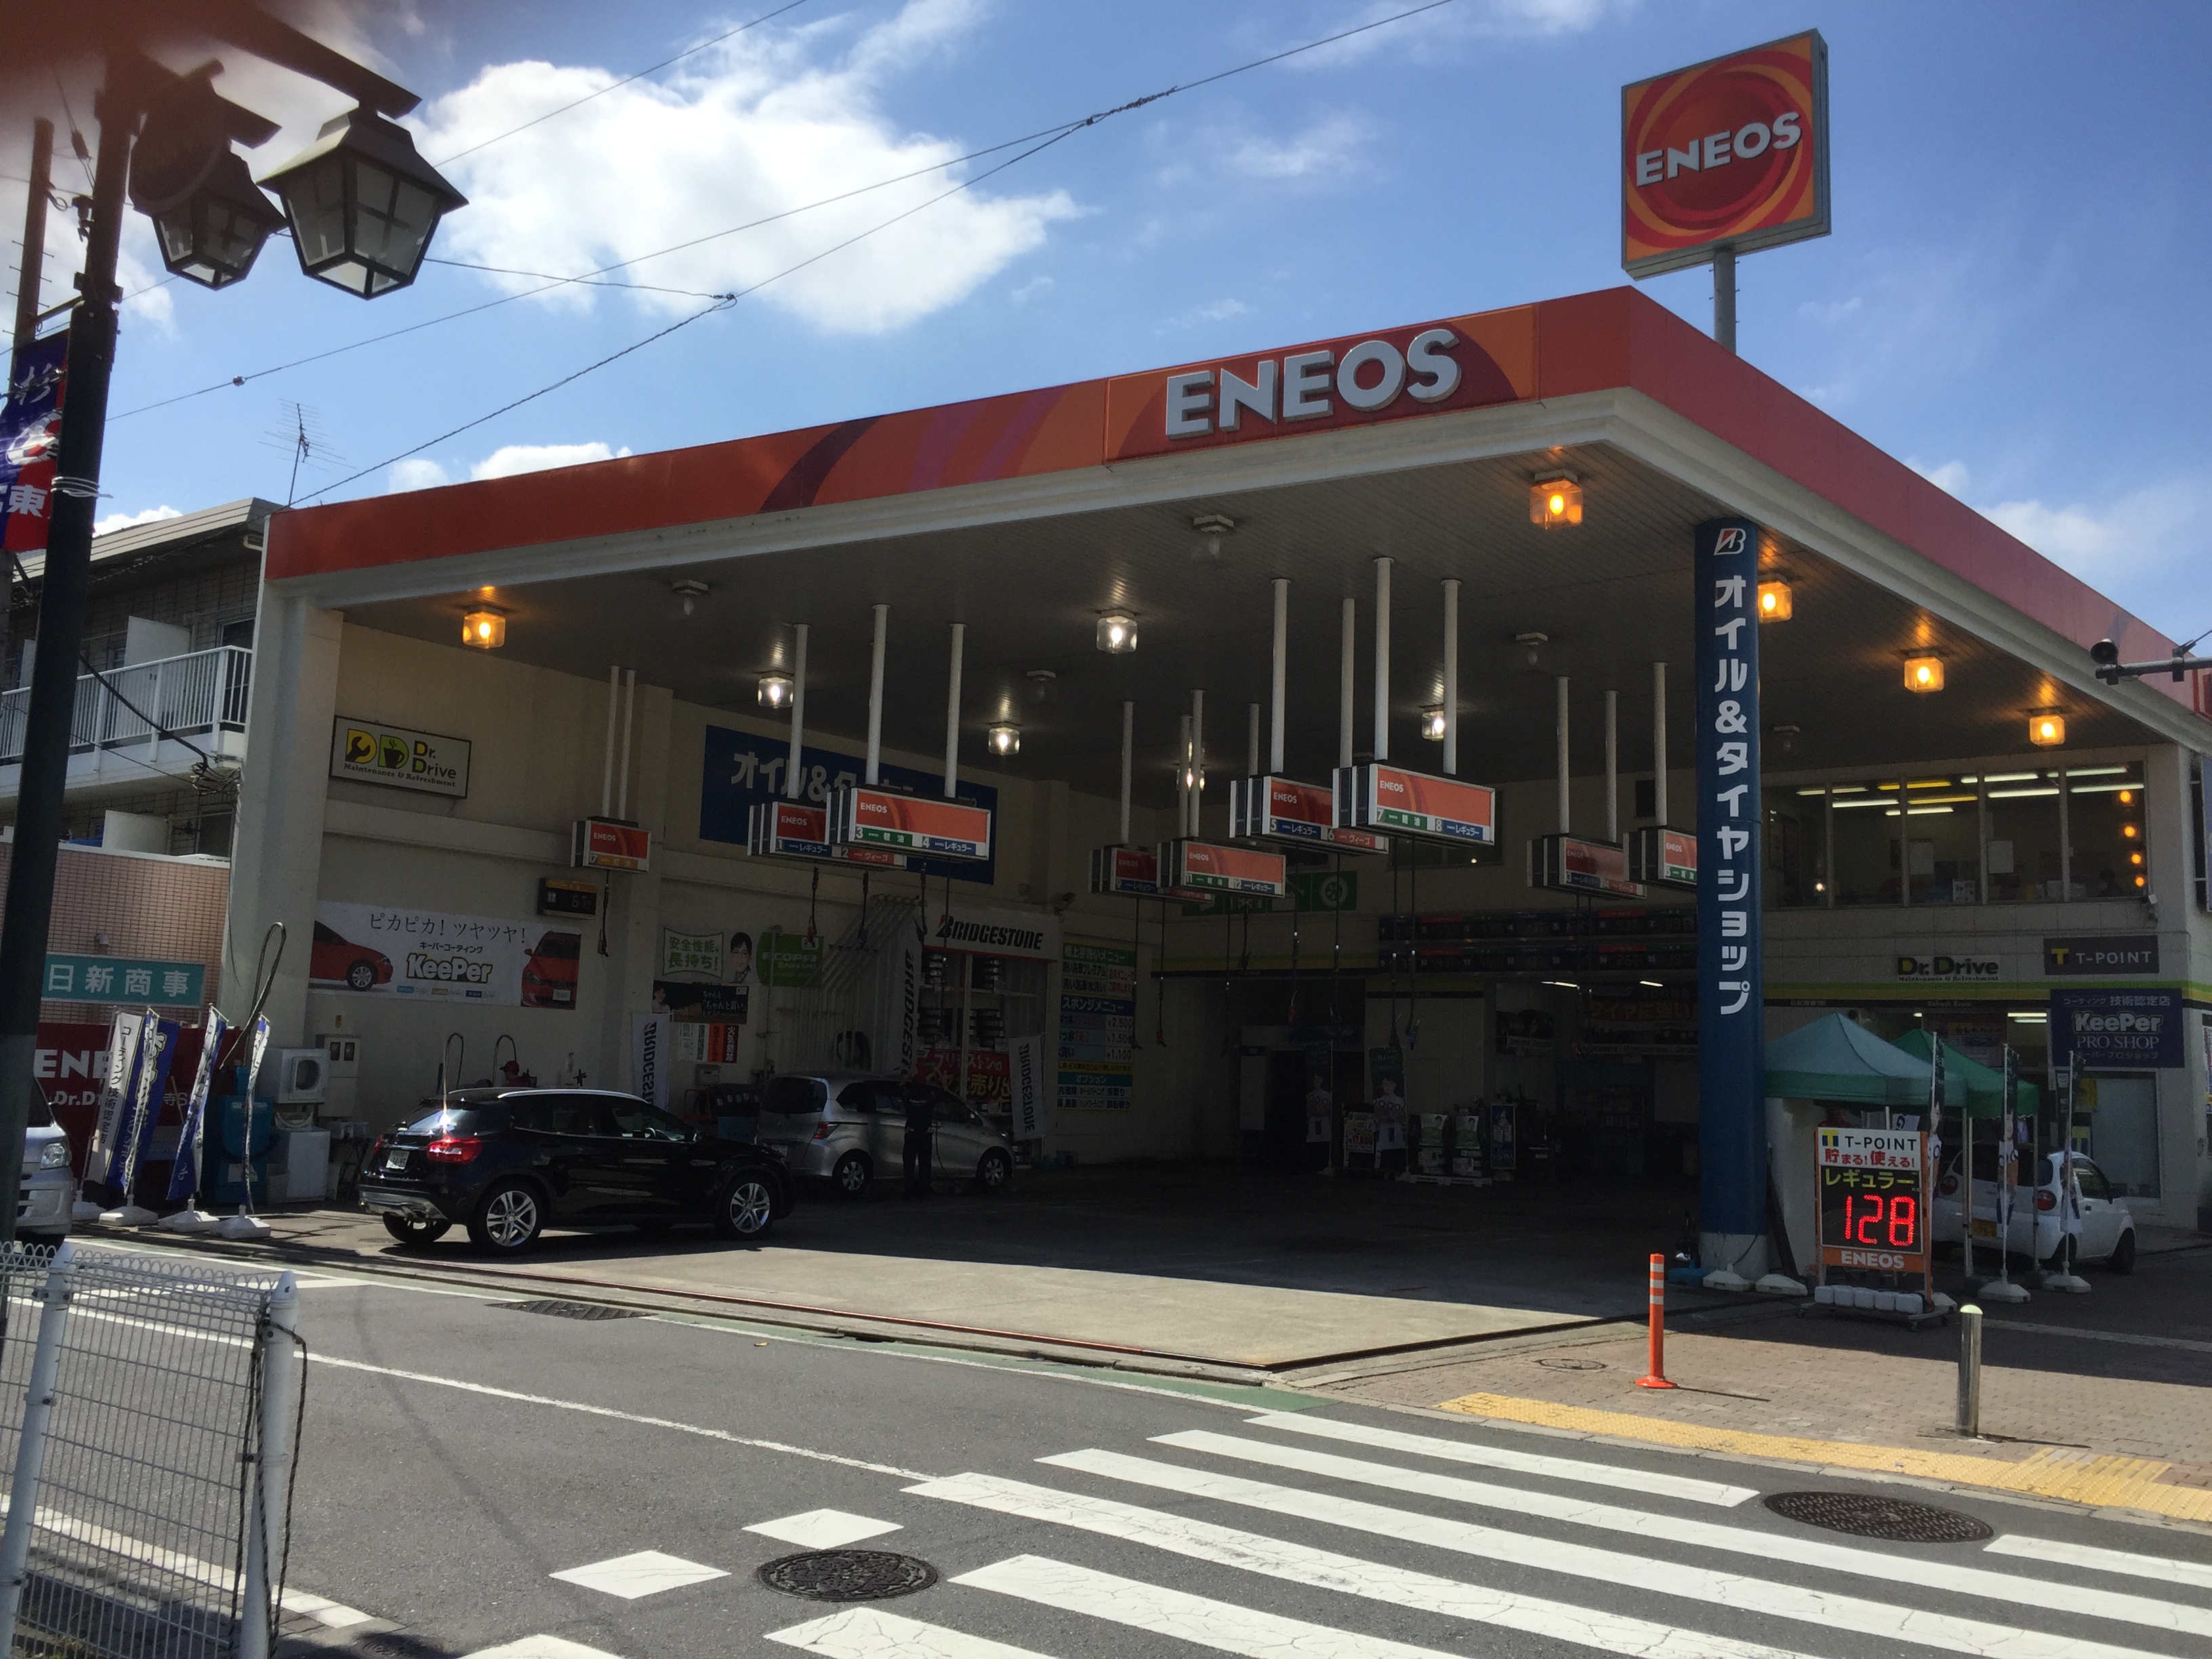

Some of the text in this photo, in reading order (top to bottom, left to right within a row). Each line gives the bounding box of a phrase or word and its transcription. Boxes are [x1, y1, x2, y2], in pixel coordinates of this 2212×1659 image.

[1637, 111, 1802, 187] ENEOS
[1165, 328, 1461, 440] ENEOS
[413, 740, 436, 759] Dr.
[411, 757, 457, 779] Drive
[343, 763, 395, 778] Maintenance
[406, 773, 455, 787] Refreshment
[1380, 780, 1404, 793] ENEOS
[1273, 792, 1297, 804] ENEOS
[1714, 575, 1750, 1015] オイル&タイヤショップ
[860, 802, 887, 813] ENEOS
[781, 815, 807, 826] ENEOS
[1377, 809, 1384, 821] 7
[1271, 819, 1277, 832] 5
[1291, 823, 1317, 835] レギュラー
[1435, 819, 1442, 832] 8
[1455, 824, 1479, 836] レギュラー
[594, 832, 617, 842] ENEOS
[856, 827, 863, 838] 3
[1328, 829, 1335, 841] 6
[799, 842, 828, 853] レギュラー
[922, 836, 930, 848] 4
[944, 841, 972, 853] レギュラー
[589, 855, 598, 863] 17
[842, 847, 848, 858] 2
[864, 851, 888, 862] ヴィーゴ
[1189, 852, 1209, 861] ENEOS
[1119, 859, 1139, 867] ENEOS
[370, 913, 525, 943] ピカピカ! ツヤツヤ!
[935, 914, 1044, 950] BRIDGESTONE
[2075, 951, 2152, 964] T-POINT
[407, 953, 493, 983] KeePer
[1898, 956, 1999, 975] Dr. Drive
[47, 964, 190, 998] 日新商事
[1062, 997, 1124, 1012] スポンジメニュー
[2064, 996, 2171, 1006] コーティング 技術認定店
[2072, 1010, 2164, 1034] KeePer
[2076, 1036, 2160, 1049] PRO SHOP
[1076, 1074, 1107, 1084] オプション
[1019, 1042, 1035, 1133] BRIDGESTONE
[1845, 1136, 1917, 1151] T-POINT
[1825, 1168, 1914, 1189] レギュラー
[1845, 1195, 1915, 1246] 128
[1841, 1251, 1905, 1269] ENEOS
